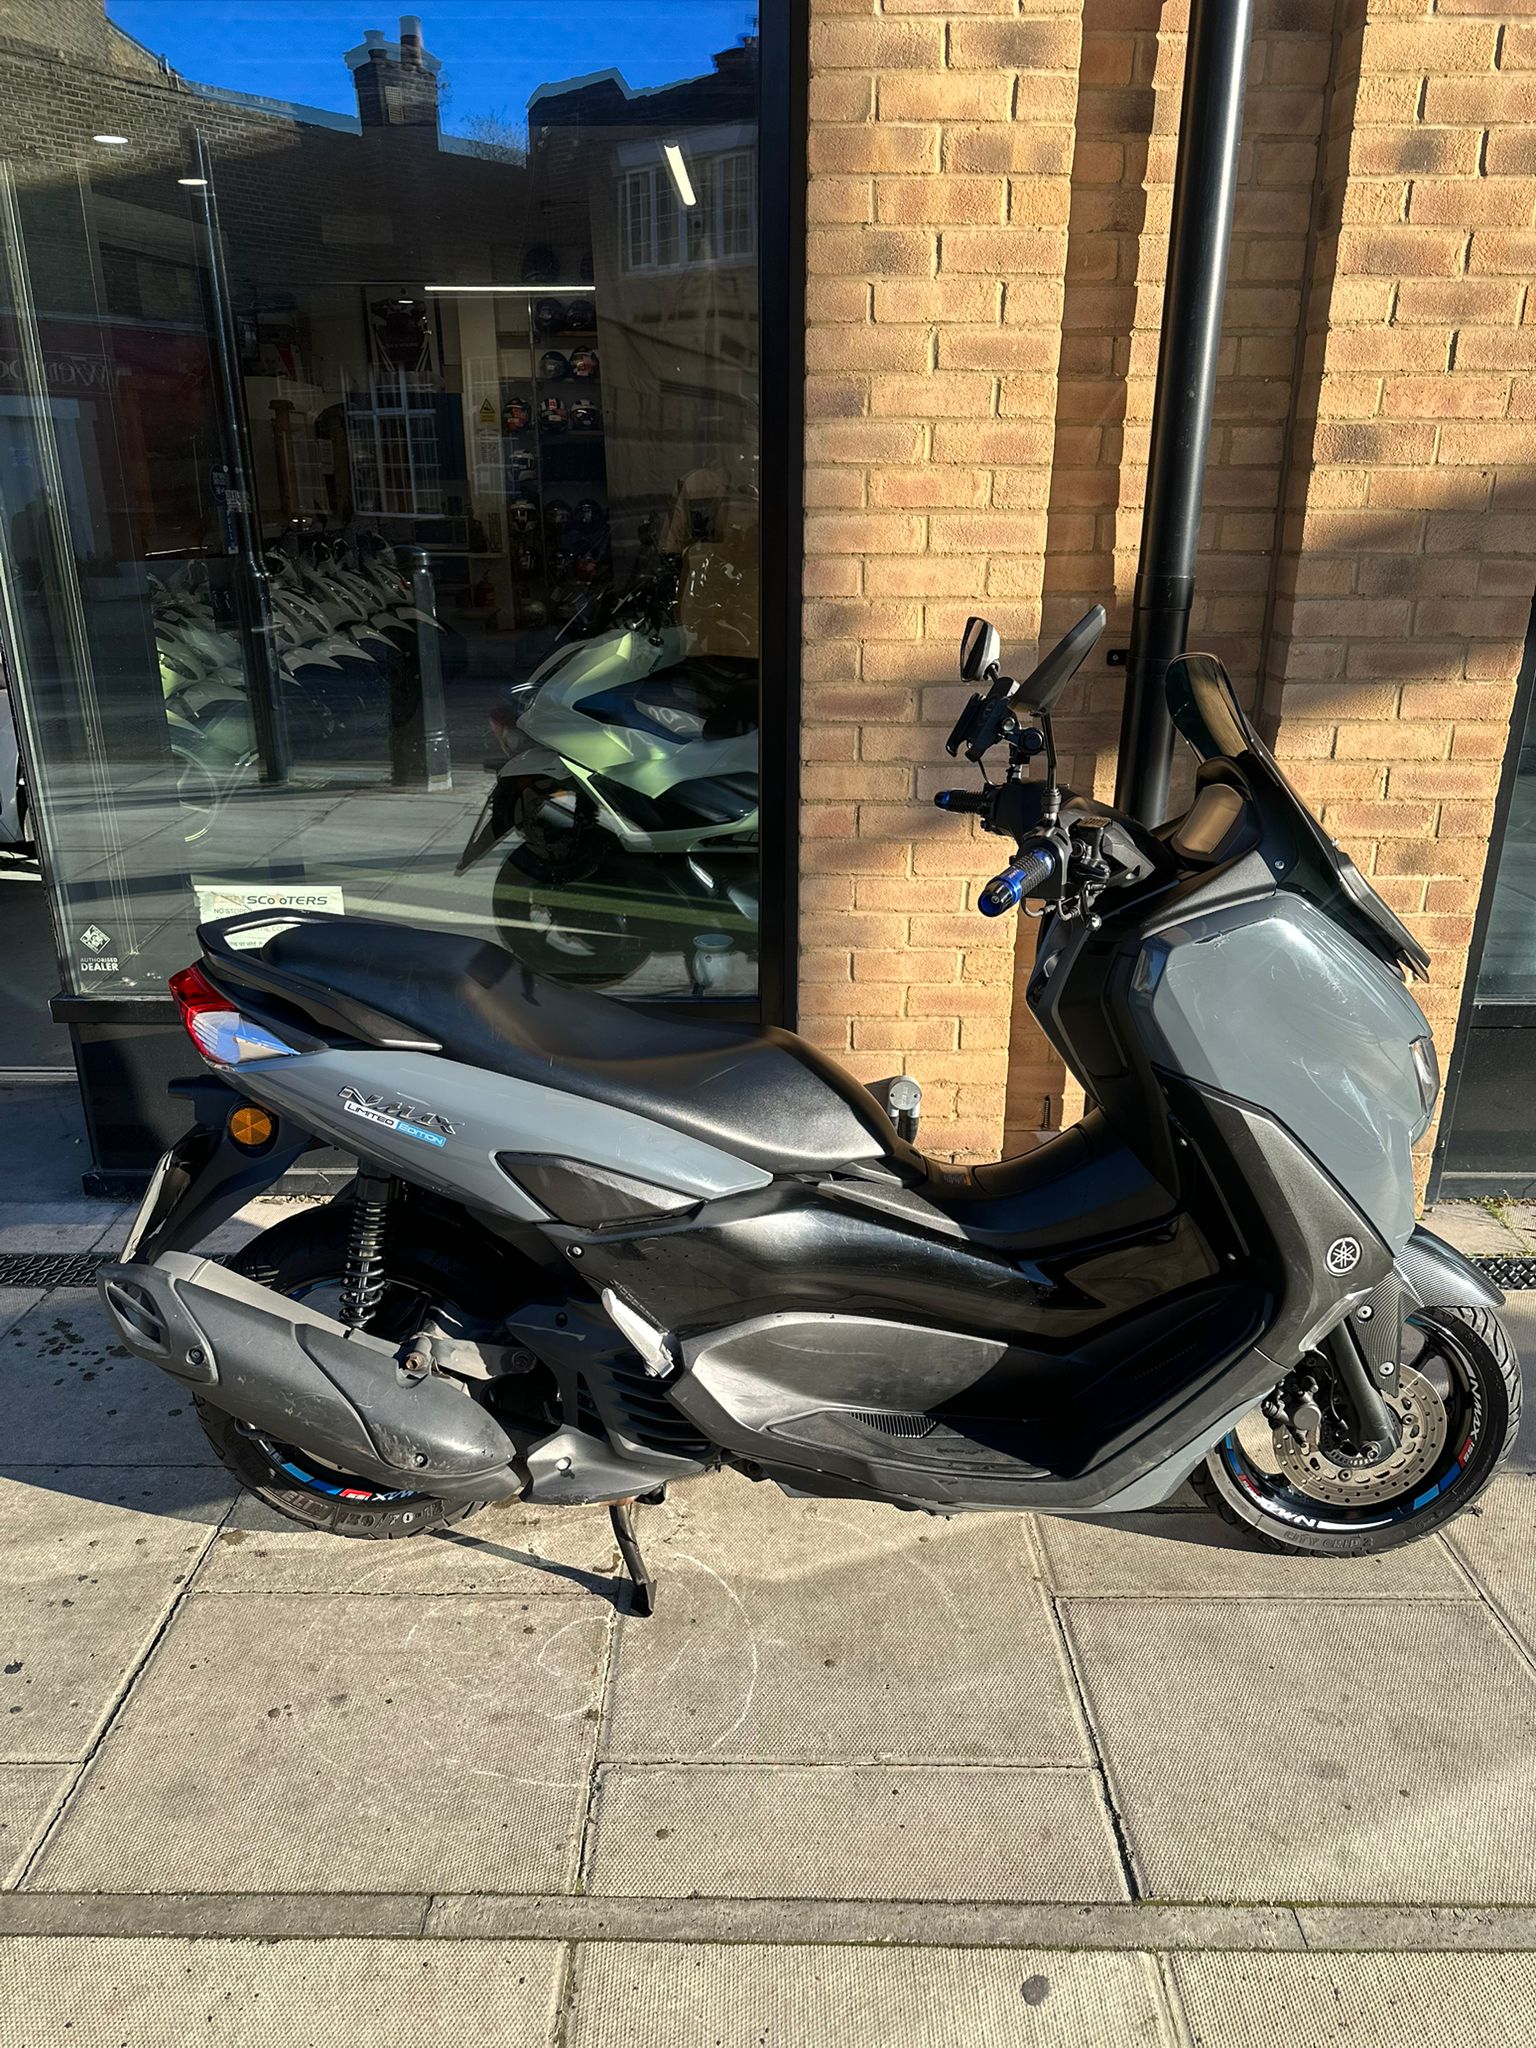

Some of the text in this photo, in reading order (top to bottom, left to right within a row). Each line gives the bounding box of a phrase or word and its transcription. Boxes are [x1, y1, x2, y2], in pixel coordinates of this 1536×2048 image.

[81, 962, 120, 972] DEALER
[347, 1102, 444, 1145] LIMITED EDITION
[1469, 1377, 1486, 1441] NMAX
[372, 1488, 416, 1502] MAX
